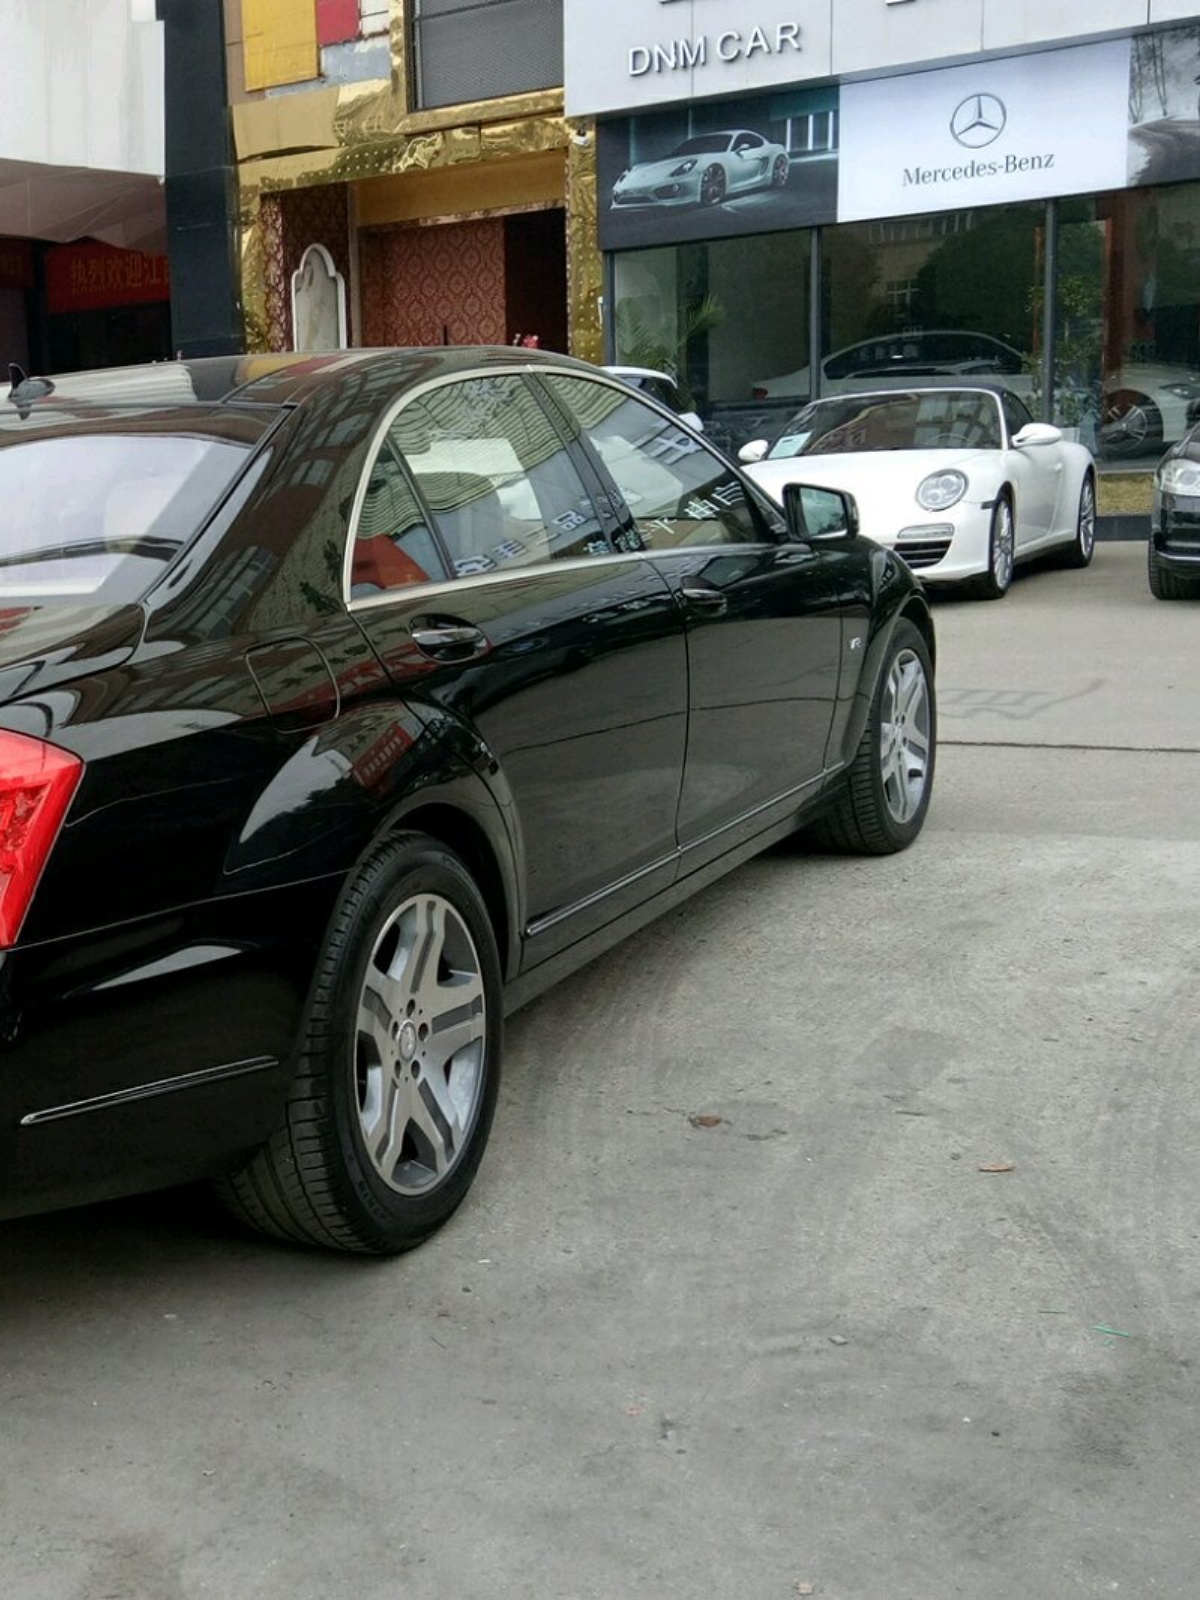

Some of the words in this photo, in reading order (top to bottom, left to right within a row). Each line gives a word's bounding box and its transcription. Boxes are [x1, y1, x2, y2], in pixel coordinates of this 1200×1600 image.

[628, 36, 707, 77] DNM
[716, 22, 802, 62] CAR
[902, 153, 1055, 187] Mercedes-Benz
